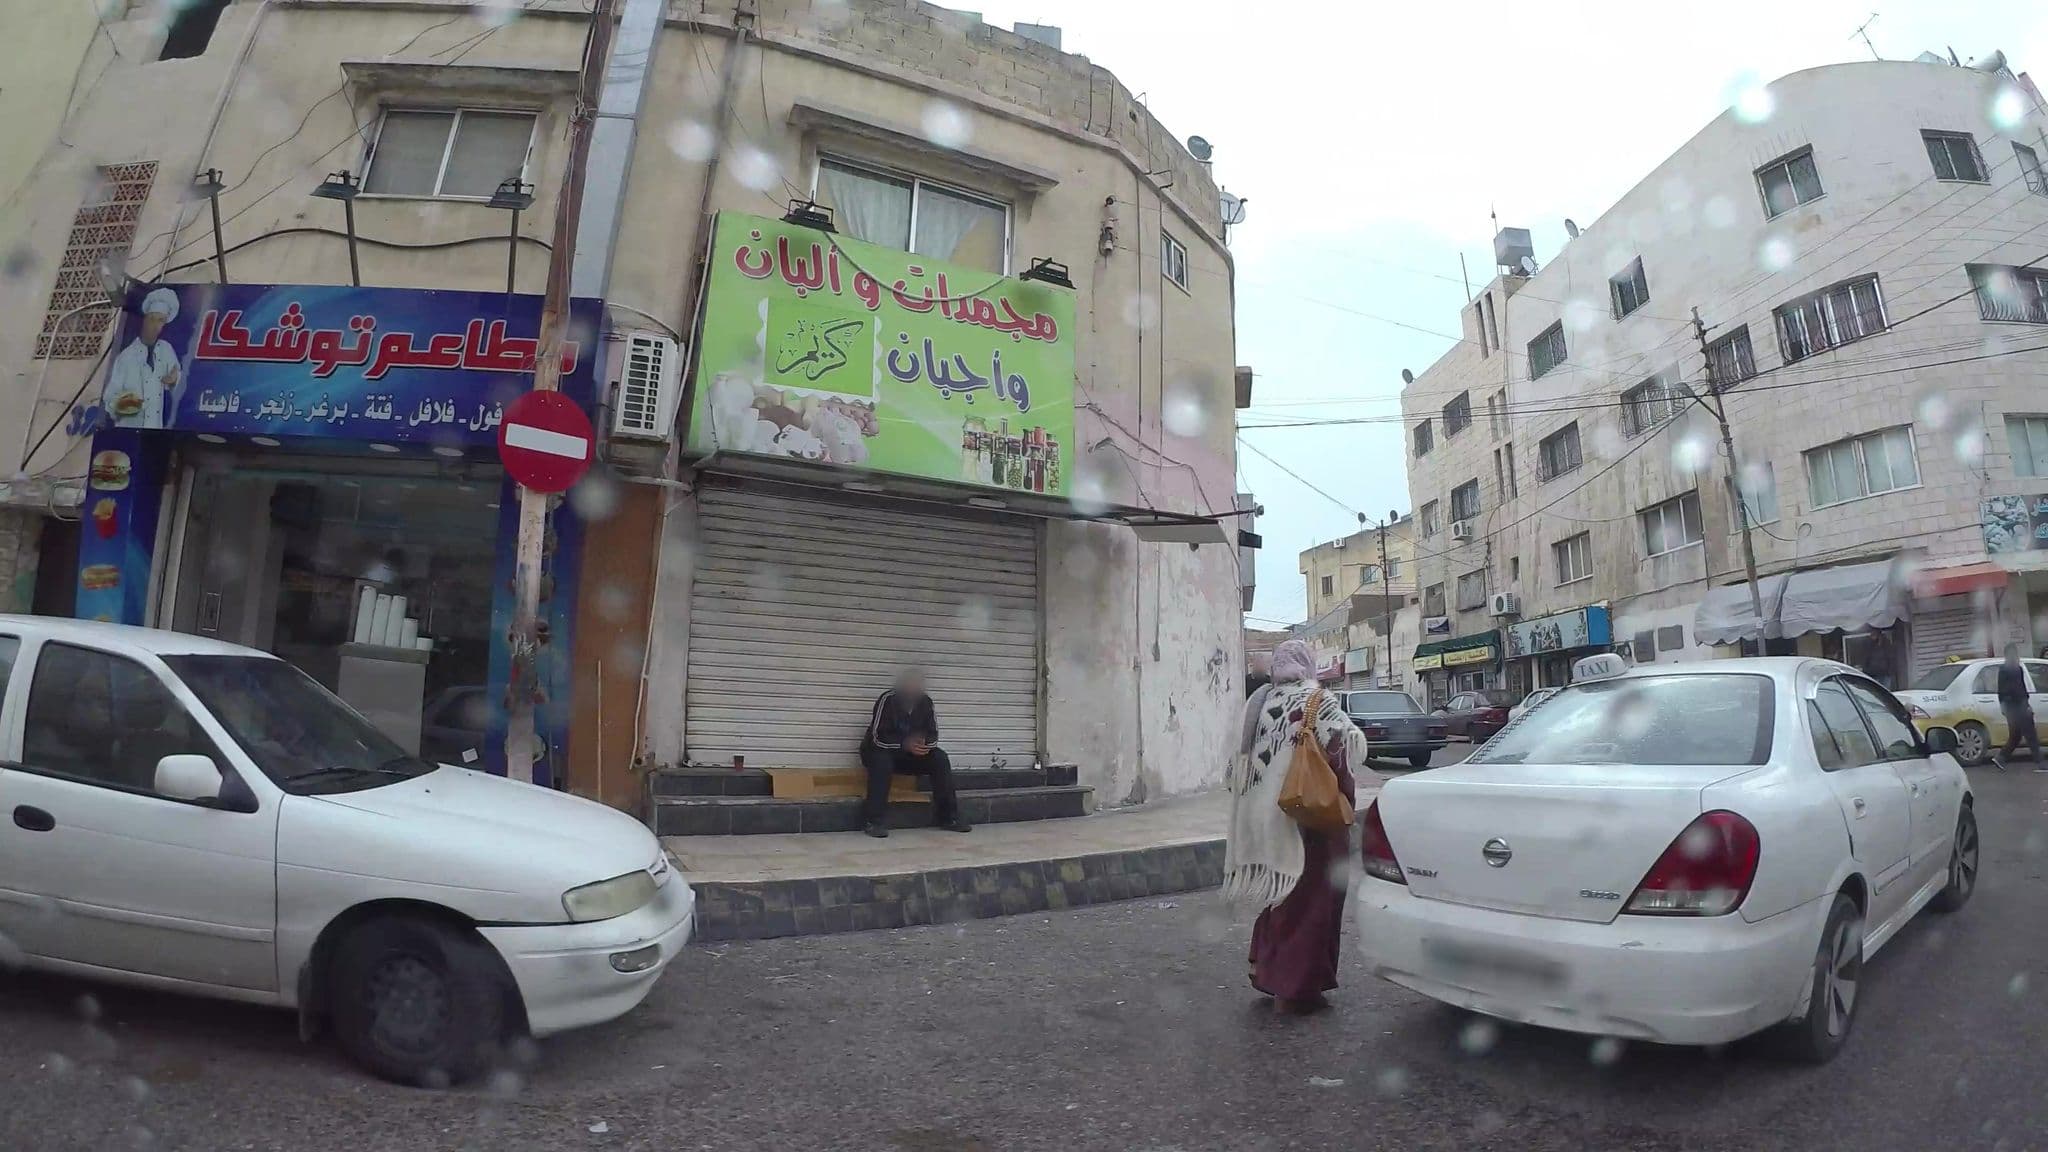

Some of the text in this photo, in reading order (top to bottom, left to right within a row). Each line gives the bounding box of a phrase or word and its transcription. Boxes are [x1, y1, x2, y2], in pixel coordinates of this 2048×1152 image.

[734, 229, 842, 298] ألبان
[893, 265, 1058, 342] مجمدات
[195, 302, 376, 378] توشكا
[887, 333, 1029, 412] وأجبان
[199, 389, 503, 431] فول فلافل فتة برغر زنجر فاهيتا
[1576, 660, 1609, 677] TAXI
